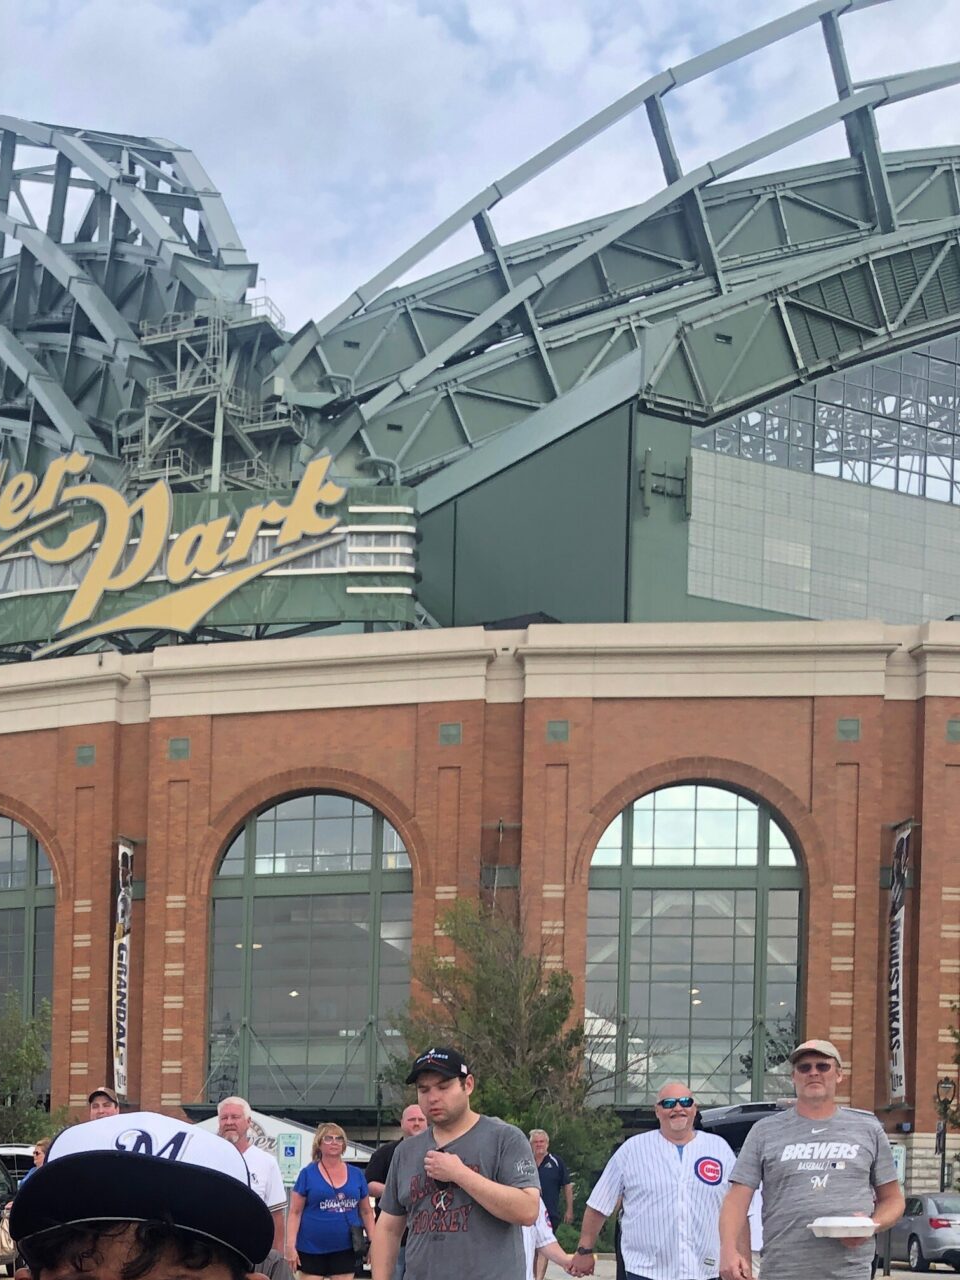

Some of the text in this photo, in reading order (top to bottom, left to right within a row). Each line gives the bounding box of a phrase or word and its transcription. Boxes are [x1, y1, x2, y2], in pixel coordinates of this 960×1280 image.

[29, 454, 348, 634] Park
[116, 942, 128, 1052] GRANDAL
[889, 919, 901, 1052] MOUSTAKAS
[781, 1142, 860, 1162] BREWERS
[811, 1174, 830, 1190] M
[411, 1204, 474, 1235] HOCKEY
